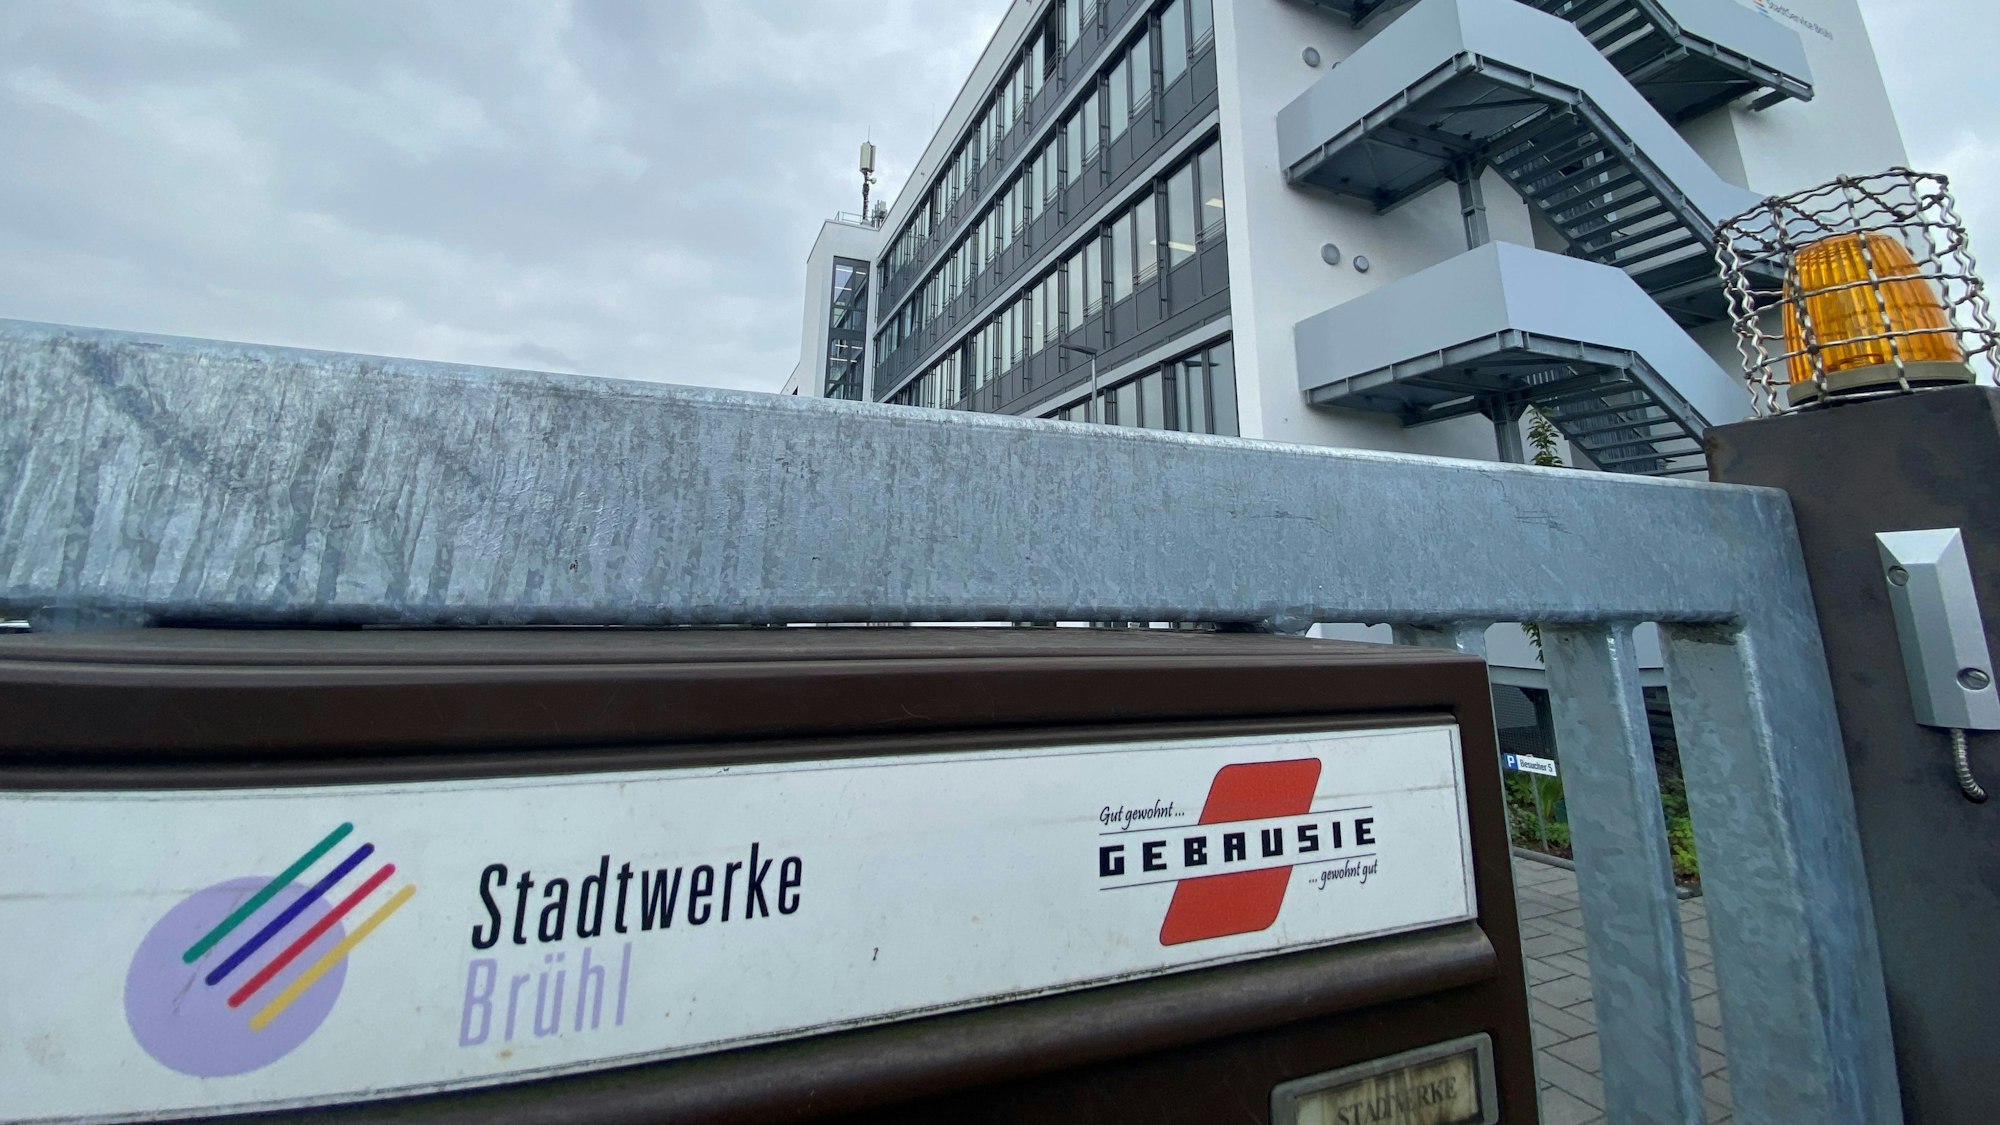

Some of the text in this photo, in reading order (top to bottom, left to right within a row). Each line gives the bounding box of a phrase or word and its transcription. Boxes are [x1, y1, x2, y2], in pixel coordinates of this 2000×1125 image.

[1506, 754, 1516, 768] P
[1519, 759, 1547, 771] Besucher
[1099, 805, 1124, 826] Gut
[1099, 817, 1376, 878] GEBAUSIE
[1359, 859, 1378, 885] gut
[471, 842, 803, 950] Stadtwerke
[458, 942, 633, 1047] Brühl
[1336, 1075, 1457, 1125] STADTWERKE
